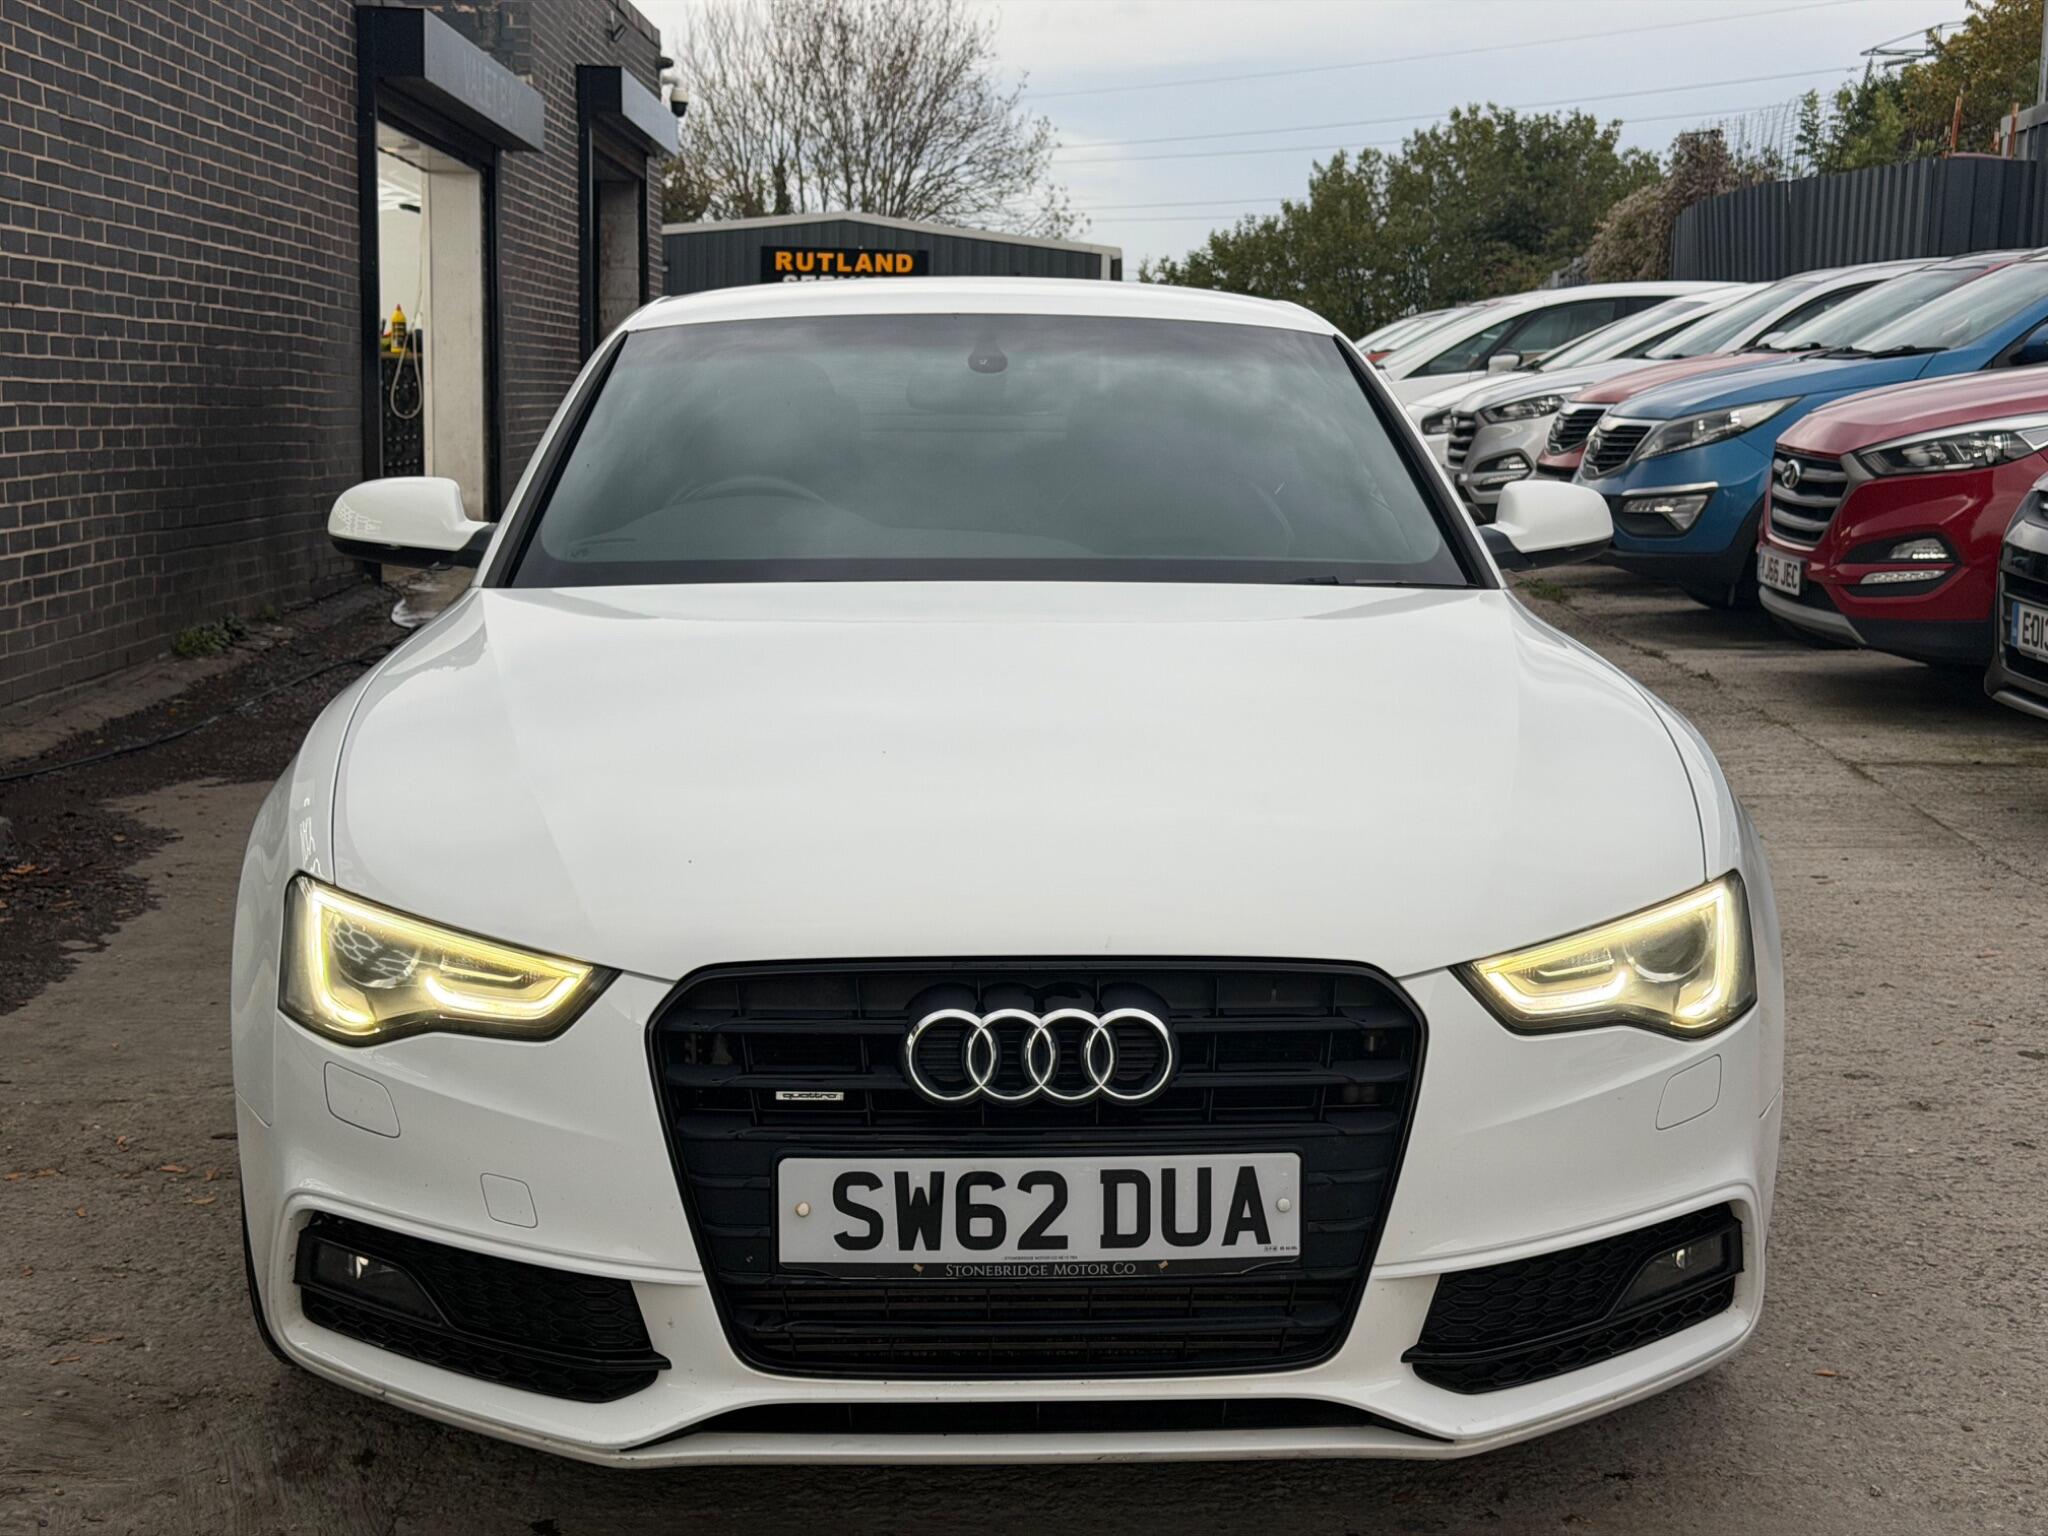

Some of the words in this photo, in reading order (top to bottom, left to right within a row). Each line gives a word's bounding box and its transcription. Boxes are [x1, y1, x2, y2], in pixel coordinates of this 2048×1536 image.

[775, 251, 914, 273] RUTLAND
[1781, 562, 1798, 588] JEC
[782, 1092, 837, 1100] quattro
[833, 1171, 1069, 1251] SW62
[1100, 1166, 1272, 1249] DUA
[946, 1264, 1049, 1277] STONEBRIDGE
[1053, 1263, 1109, 1276] MOTOR
